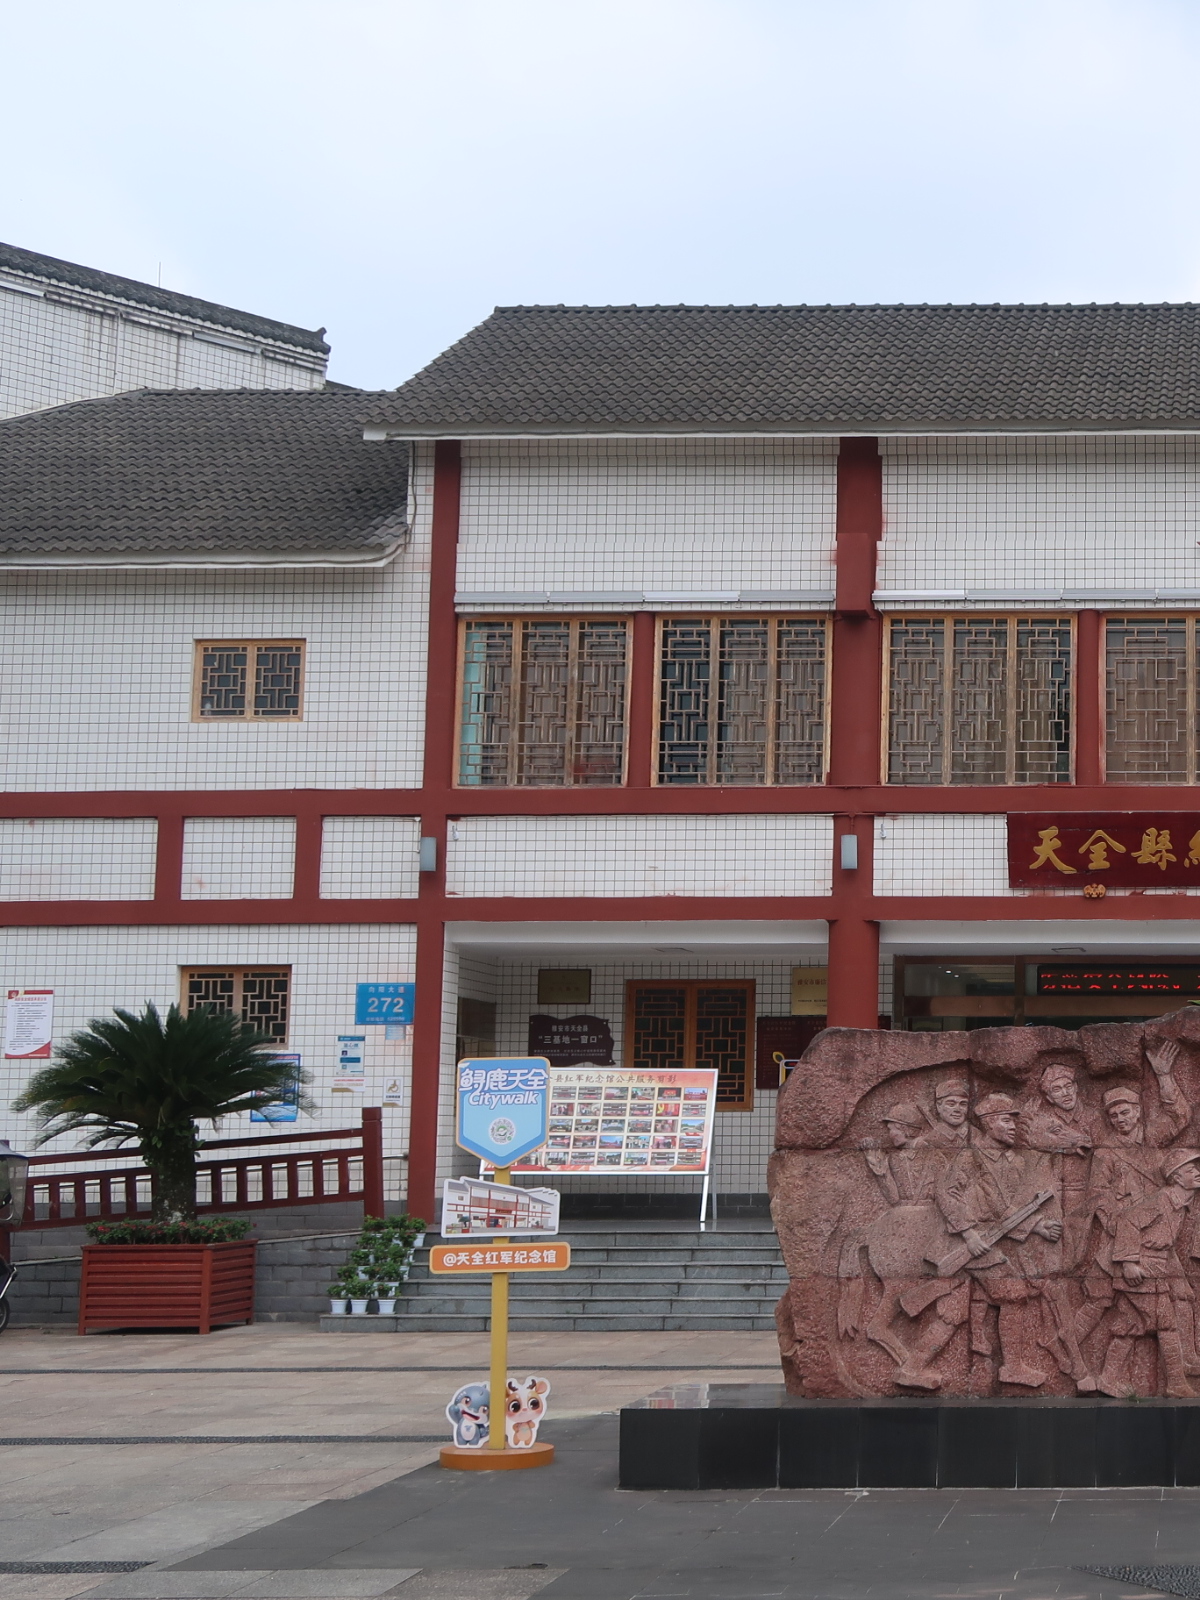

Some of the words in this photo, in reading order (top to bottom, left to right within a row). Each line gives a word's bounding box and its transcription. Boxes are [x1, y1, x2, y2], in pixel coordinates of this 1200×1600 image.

[367, 997, 404, 1013] 272
[459, 1068, 548, 1091] 鲟鹿天全
[549, 1073, 677, 1084] 县红军纪念馆公共服务剪影
[469, 1091, 539, 1110] Citywalk
[443, 1249, 557, 1267] @天全红军纪念馆
